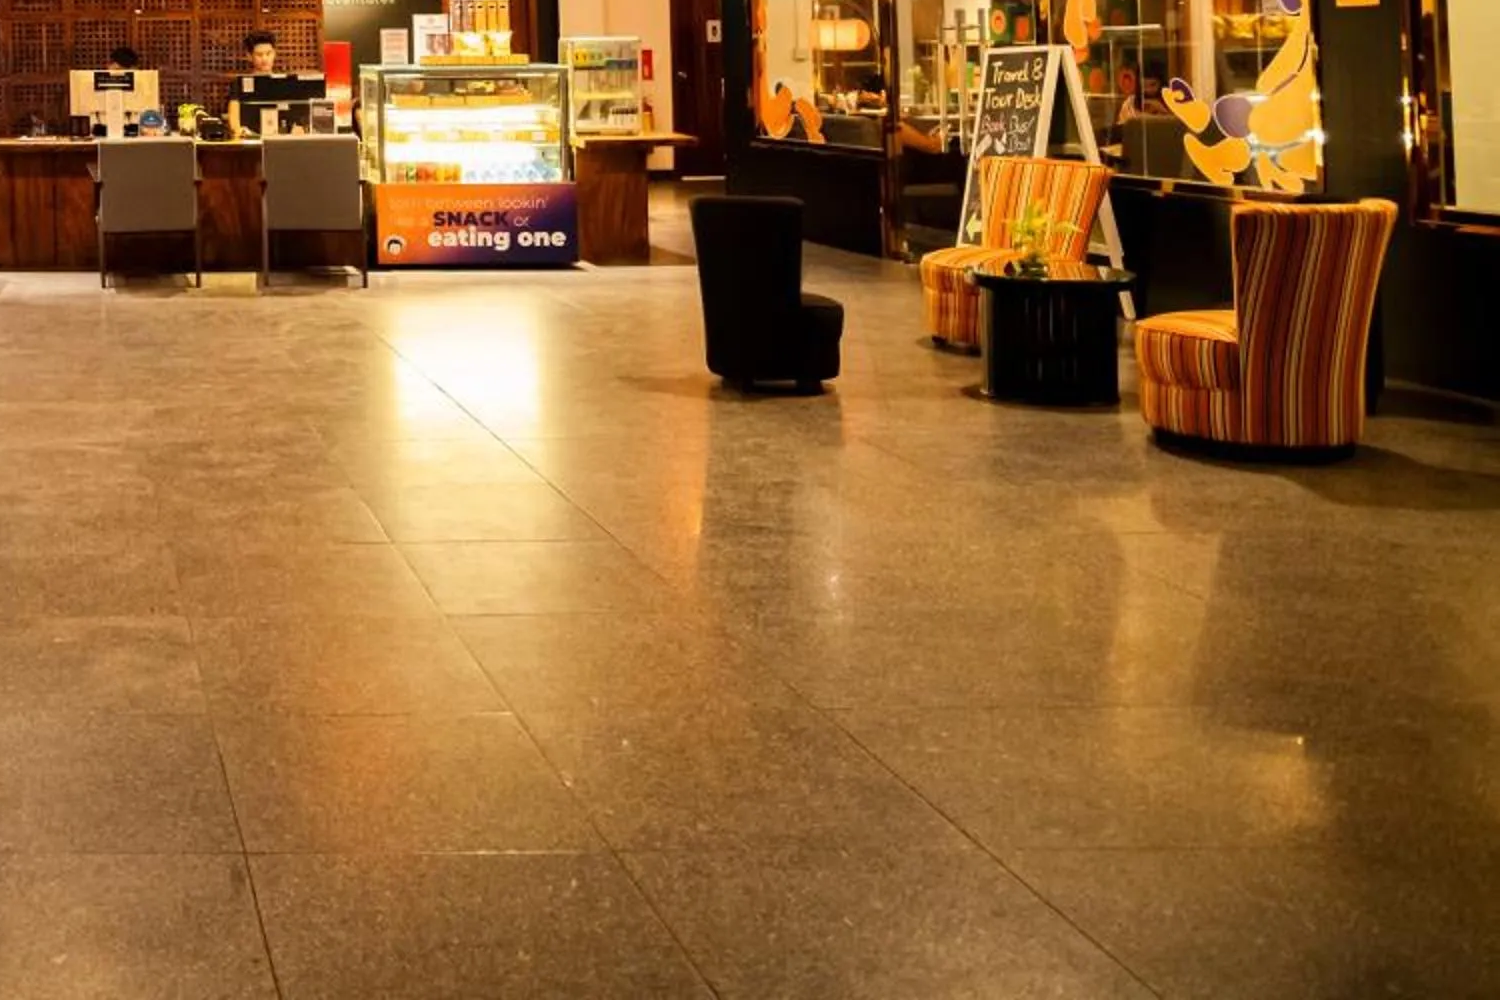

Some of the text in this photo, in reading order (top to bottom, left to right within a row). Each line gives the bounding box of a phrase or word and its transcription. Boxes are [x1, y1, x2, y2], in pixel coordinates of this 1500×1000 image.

[985, 87, 1012, 109] Tour
[433, 211, 509, 227] SNACK
[428, 225, 567, 251] eating one
